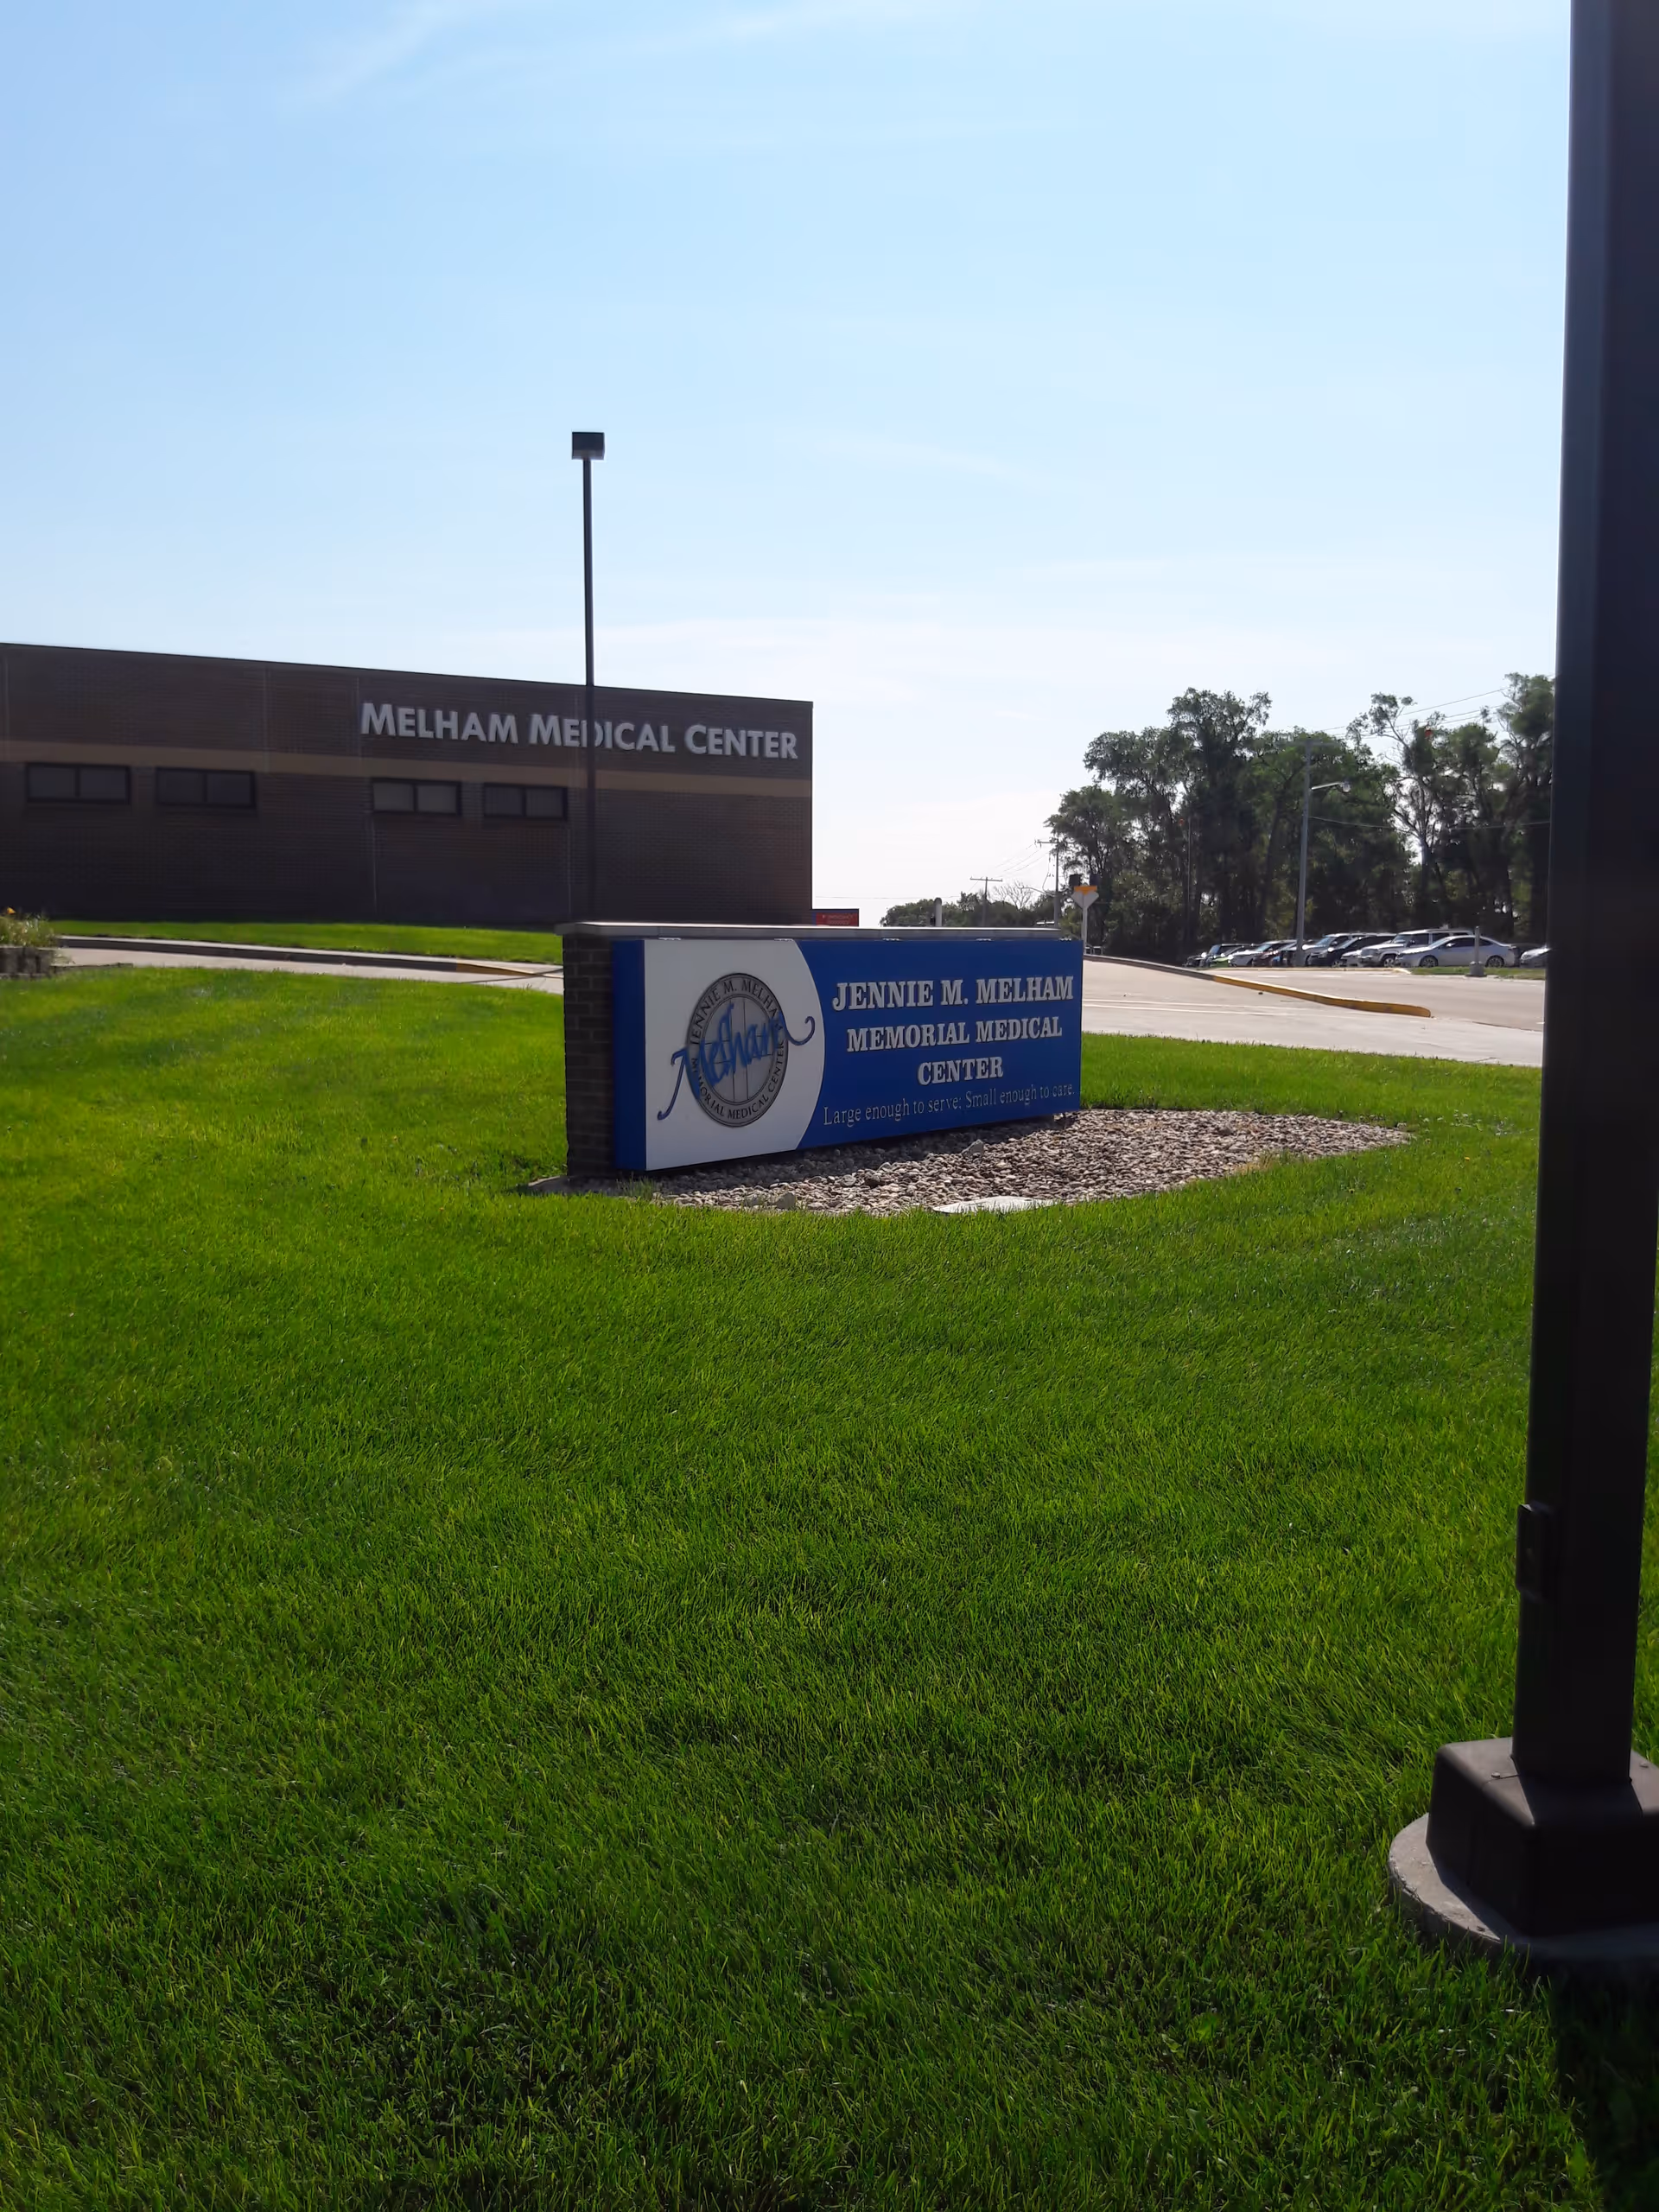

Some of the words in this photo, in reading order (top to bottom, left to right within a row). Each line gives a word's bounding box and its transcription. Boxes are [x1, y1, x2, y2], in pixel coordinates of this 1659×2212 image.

[360, 702, 518, 744] MELHAM
[529, 713, 676, 753] MEDICAL
[684, 724, 798, 759] CENTER
[832, 980, 934, 1012] JENNIE
[940, 979, 969, 1006] M.
[976, 976, 1074, 1005] MELHAM
[691, 988, 721, 1046] JENNIE
[723, 980, 737, 995] M.
[847, 1021, 969, 1052] MEMORIAL
[976, 1015, 1063, 1043] MEDICAL
[918, 1056, 1004, 1085] CENTER
[727, 1095, 769, 1120] MEDICAL
[823, 1106, 861, 1128] Large
[865, 1097, 910, 1122] enough
[913, 1100, 925, 1114] to
[965, 1088, 996, 1108] Small
[1000, 1084, 1037, 1105] enough
[1039, 1086, 1050, 1098] to
[1052, 1084, 1075, 1097] care.
